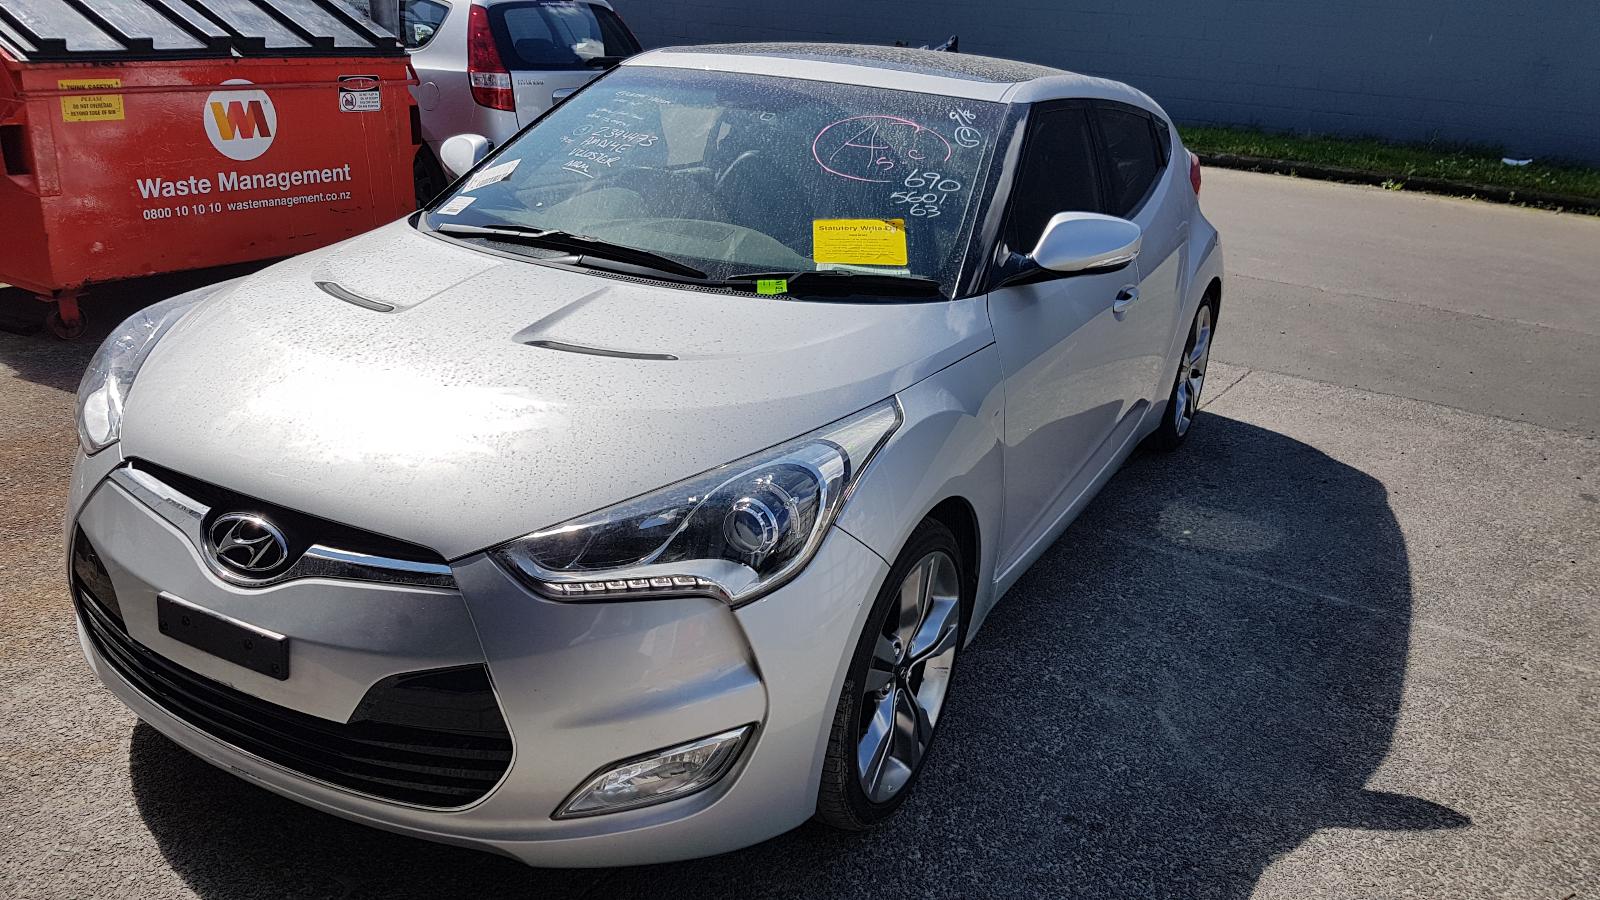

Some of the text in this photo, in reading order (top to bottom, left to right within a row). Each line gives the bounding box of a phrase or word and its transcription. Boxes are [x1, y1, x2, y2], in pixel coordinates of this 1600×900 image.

[136, 163, 352, 199] Waste Management
[904, 169, 961, 191] 690
[143, 191, 351, 220] 0800 10 10 10 wastemanagement.co.nz
[909, 203, 941, 218] 63
